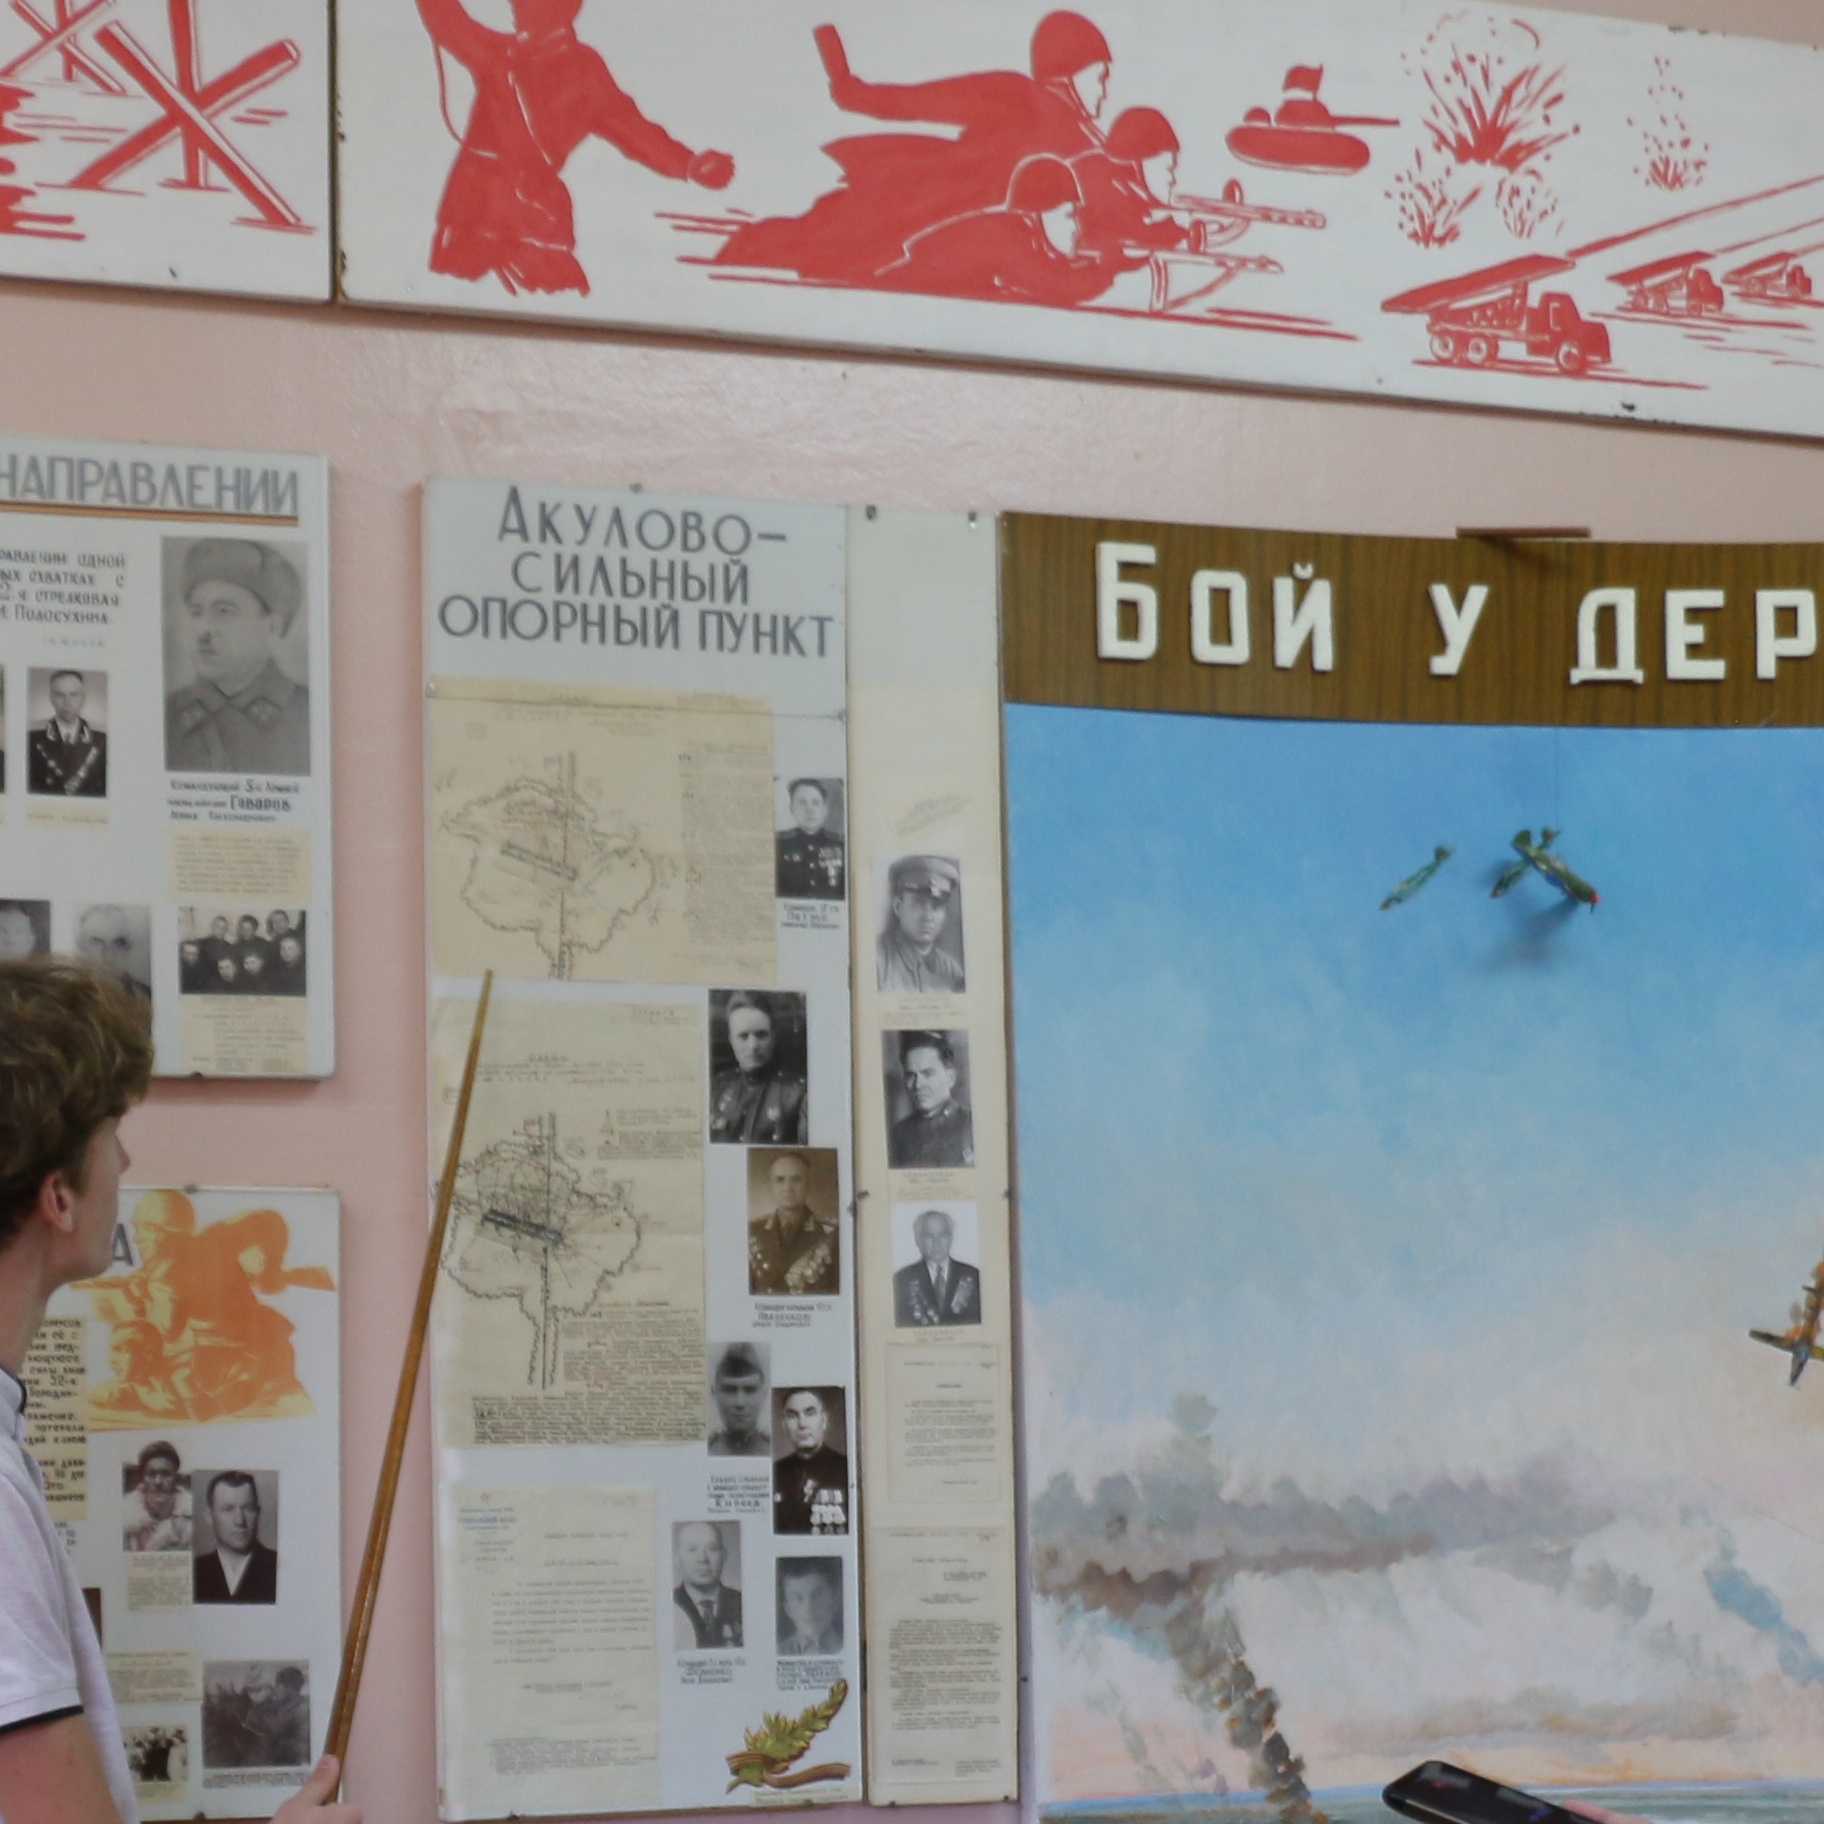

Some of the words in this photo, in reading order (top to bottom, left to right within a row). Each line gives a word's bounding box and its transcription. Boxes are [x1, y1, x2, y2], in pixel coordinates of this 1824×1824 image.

[512, 552, 748, 605] СИЛЬНЫЙ
[1095, 541, 1333, 672] БОЙ
[1429, 583, 1488, 678] У
[438, 596, 678, 650] ОПОРНЫЙ
[700, 611, 833, 658] ПУНКТ
